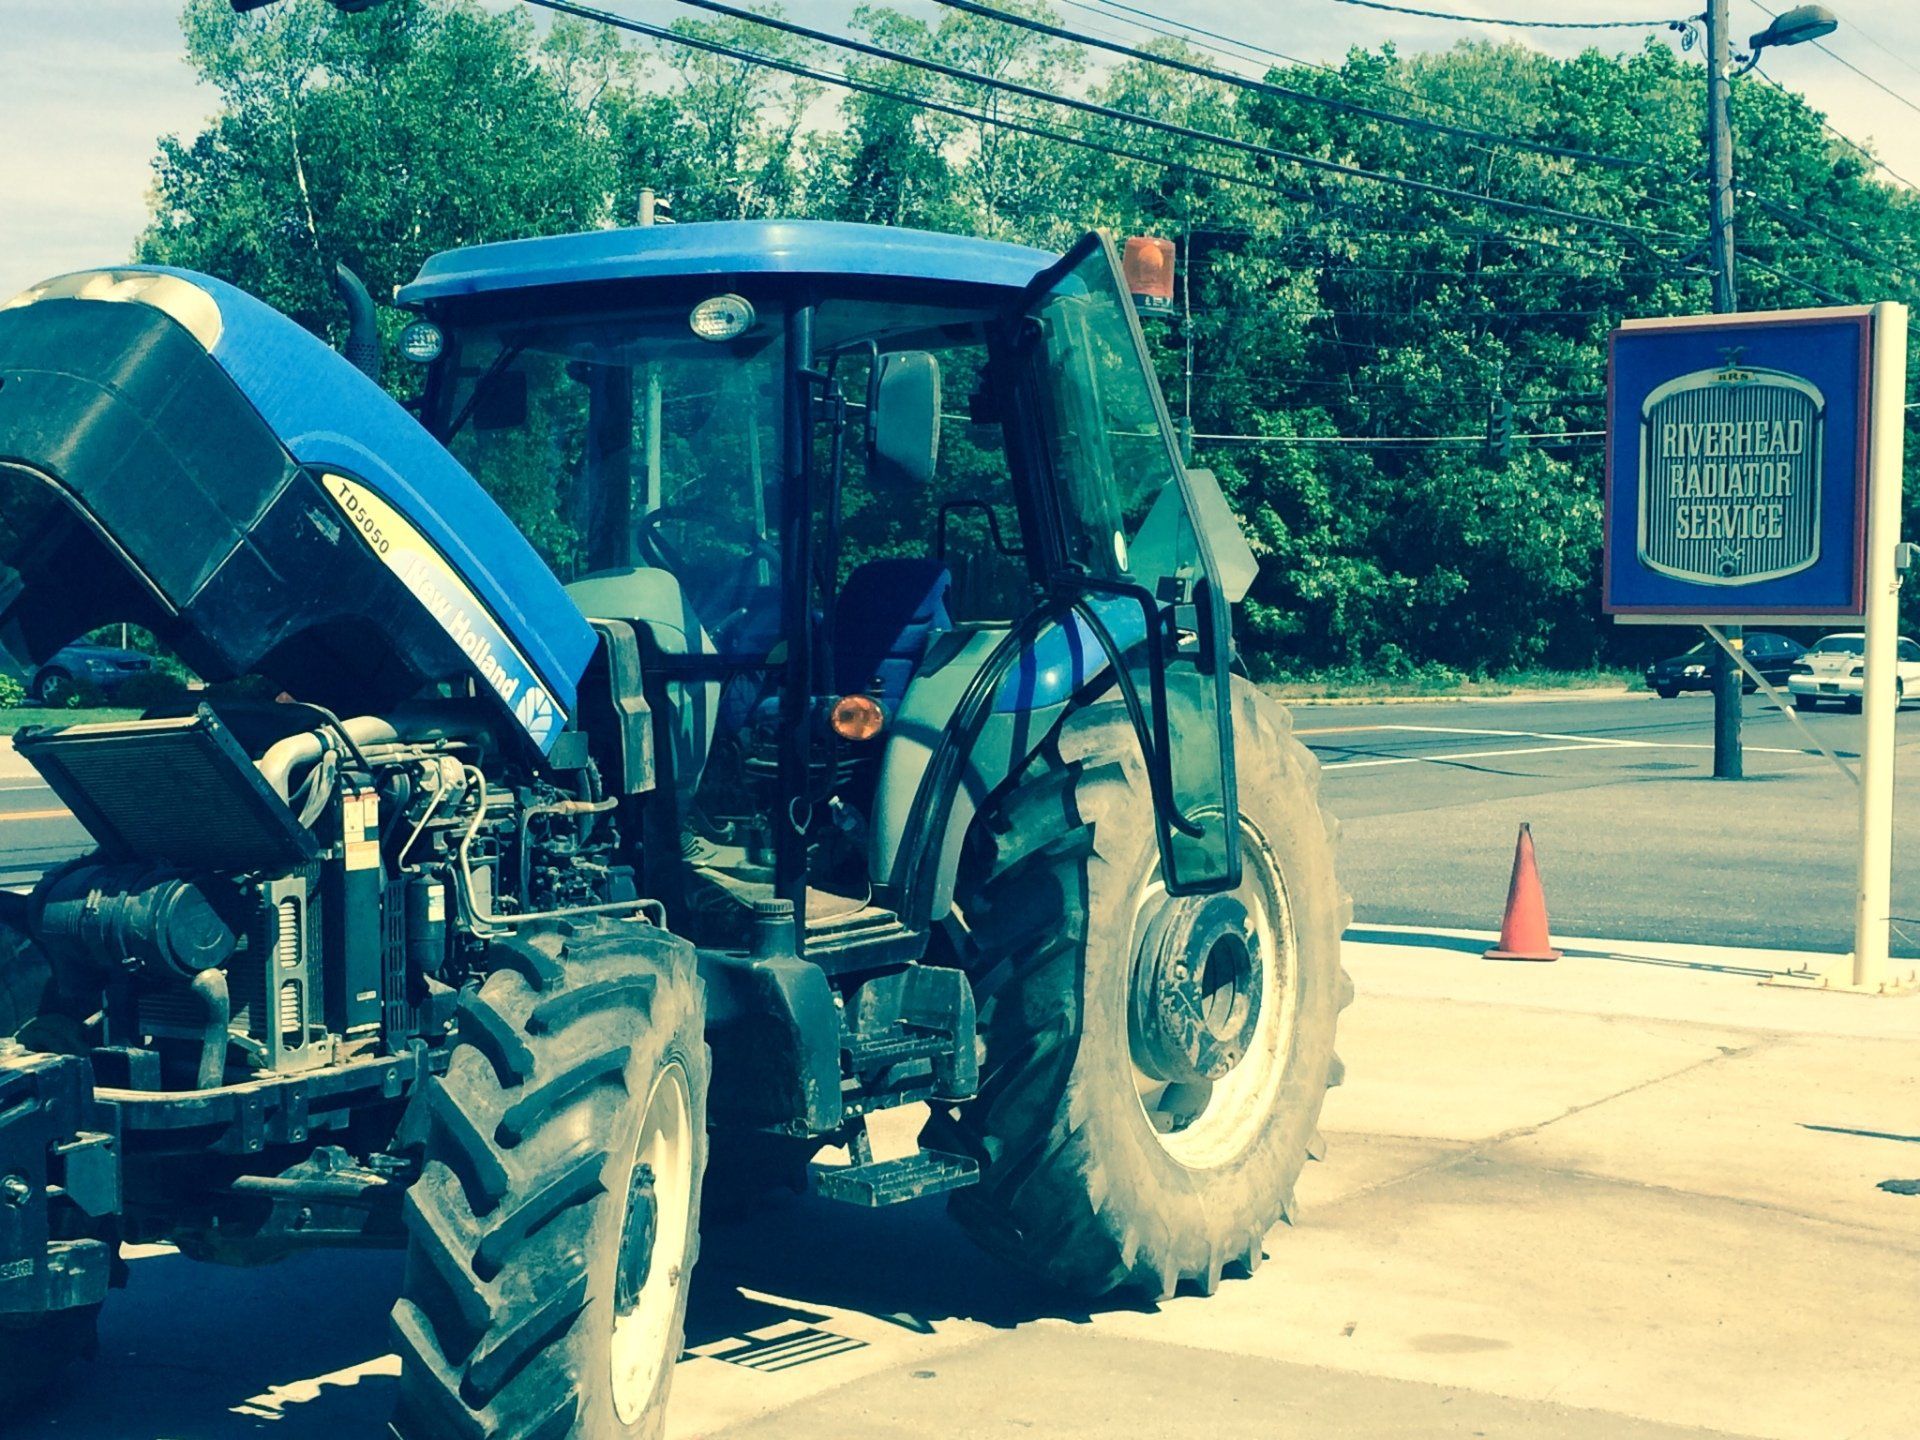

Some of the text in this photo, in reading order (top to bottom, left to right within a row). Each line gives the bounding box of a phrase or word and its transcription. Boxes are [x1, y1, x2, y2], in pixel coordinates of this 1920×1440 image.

[1662, 420, 1803, 458] RIVERHEAD
[1670, 462, 1792, 499] RADIATOR
[338, 483, 390, 554] TD5050
[1676, 504, 1783, 540] SERVICE
[404, 557, 520, 704] New Holland
